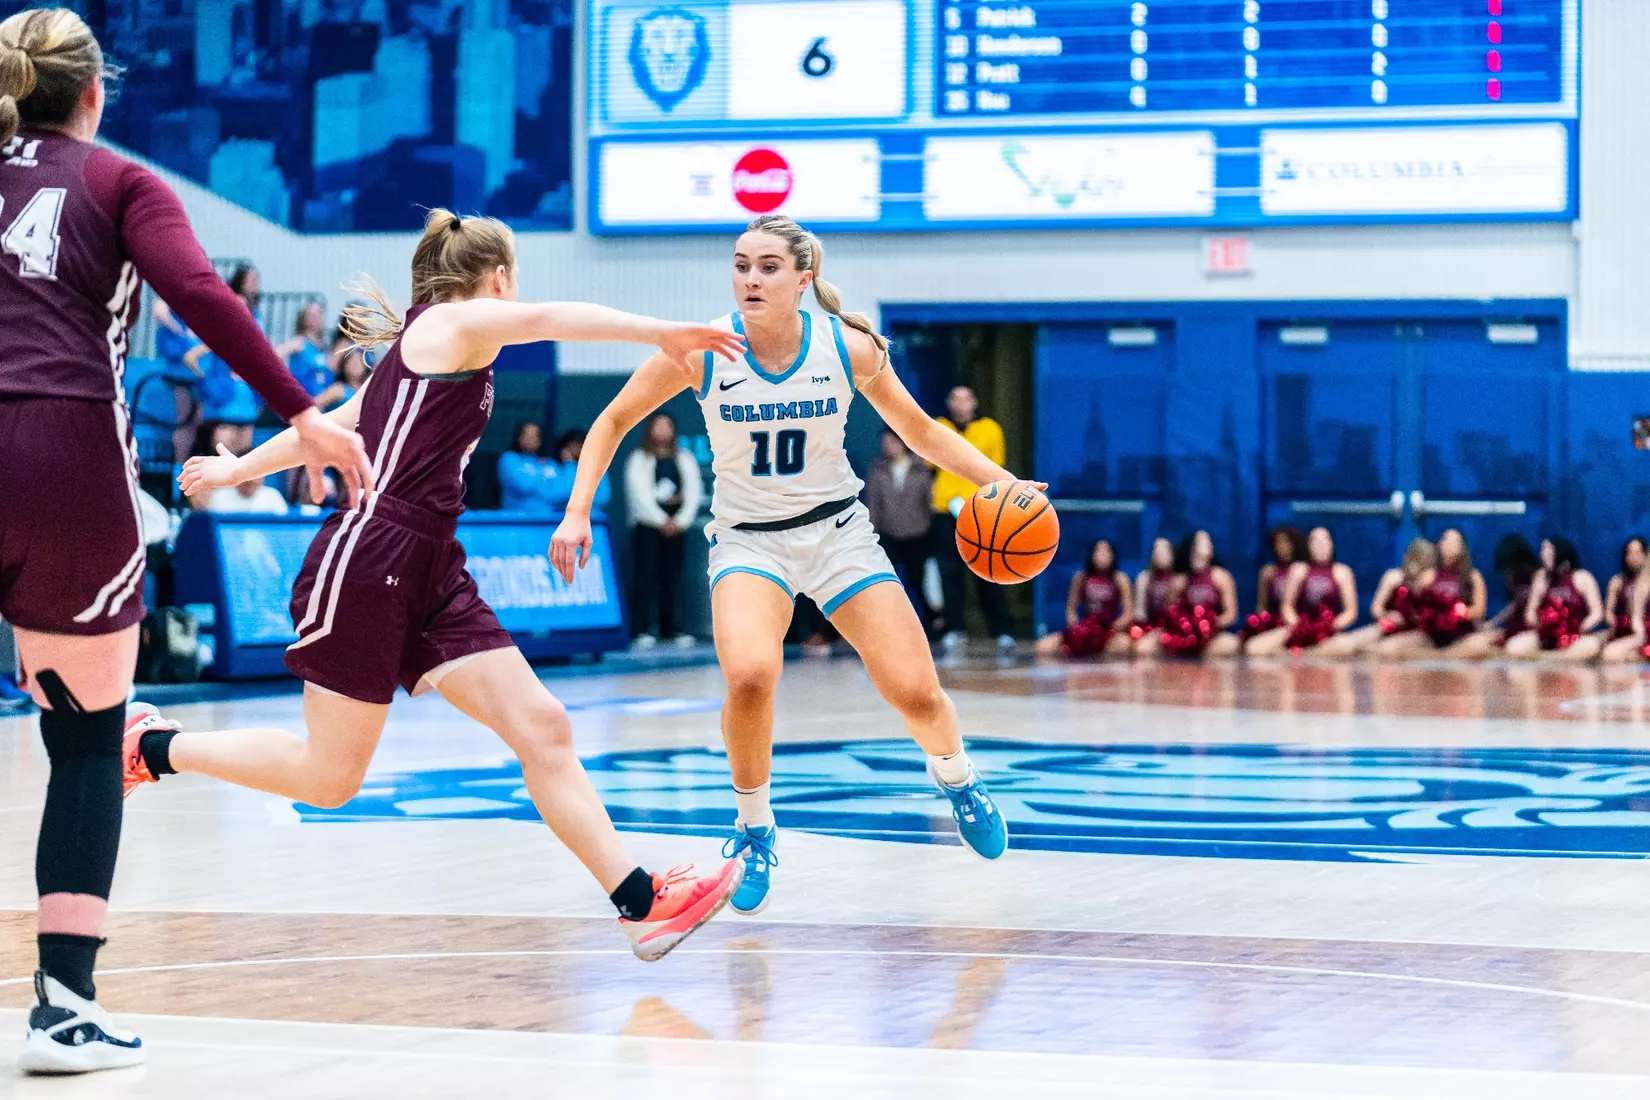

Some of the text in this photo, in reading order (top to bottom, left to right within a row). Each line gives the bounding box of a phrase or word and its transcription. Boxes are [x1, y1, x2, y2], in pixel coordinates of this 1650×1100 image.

[803, 37, 831, 77] 6
[0, 188, 67, 280] 4
[719, 397, 838, 422] COLUMBIA
[750, 428, 808, 477] 10
